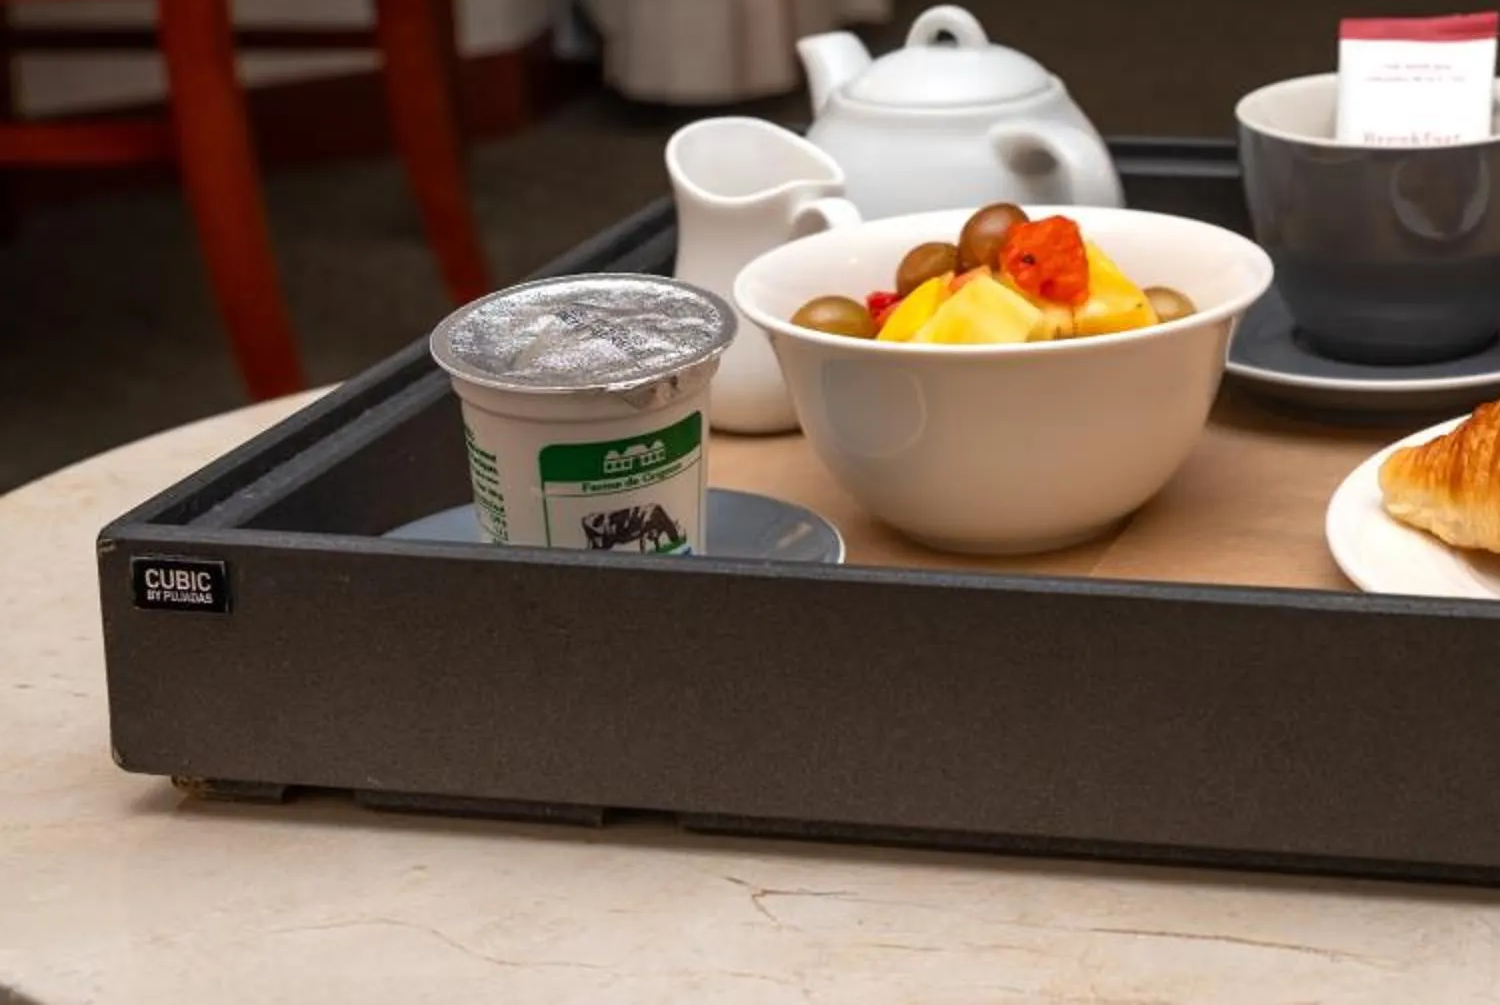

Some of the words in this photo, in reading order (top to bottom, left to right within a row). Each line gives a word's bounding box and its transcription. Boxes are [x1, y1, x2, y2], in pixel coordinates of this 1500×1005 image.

[144, 568, 212, 592] CUBIC
[146, 588, 162, 601] BY
[163, 590, 214, 604] PUJADAS
